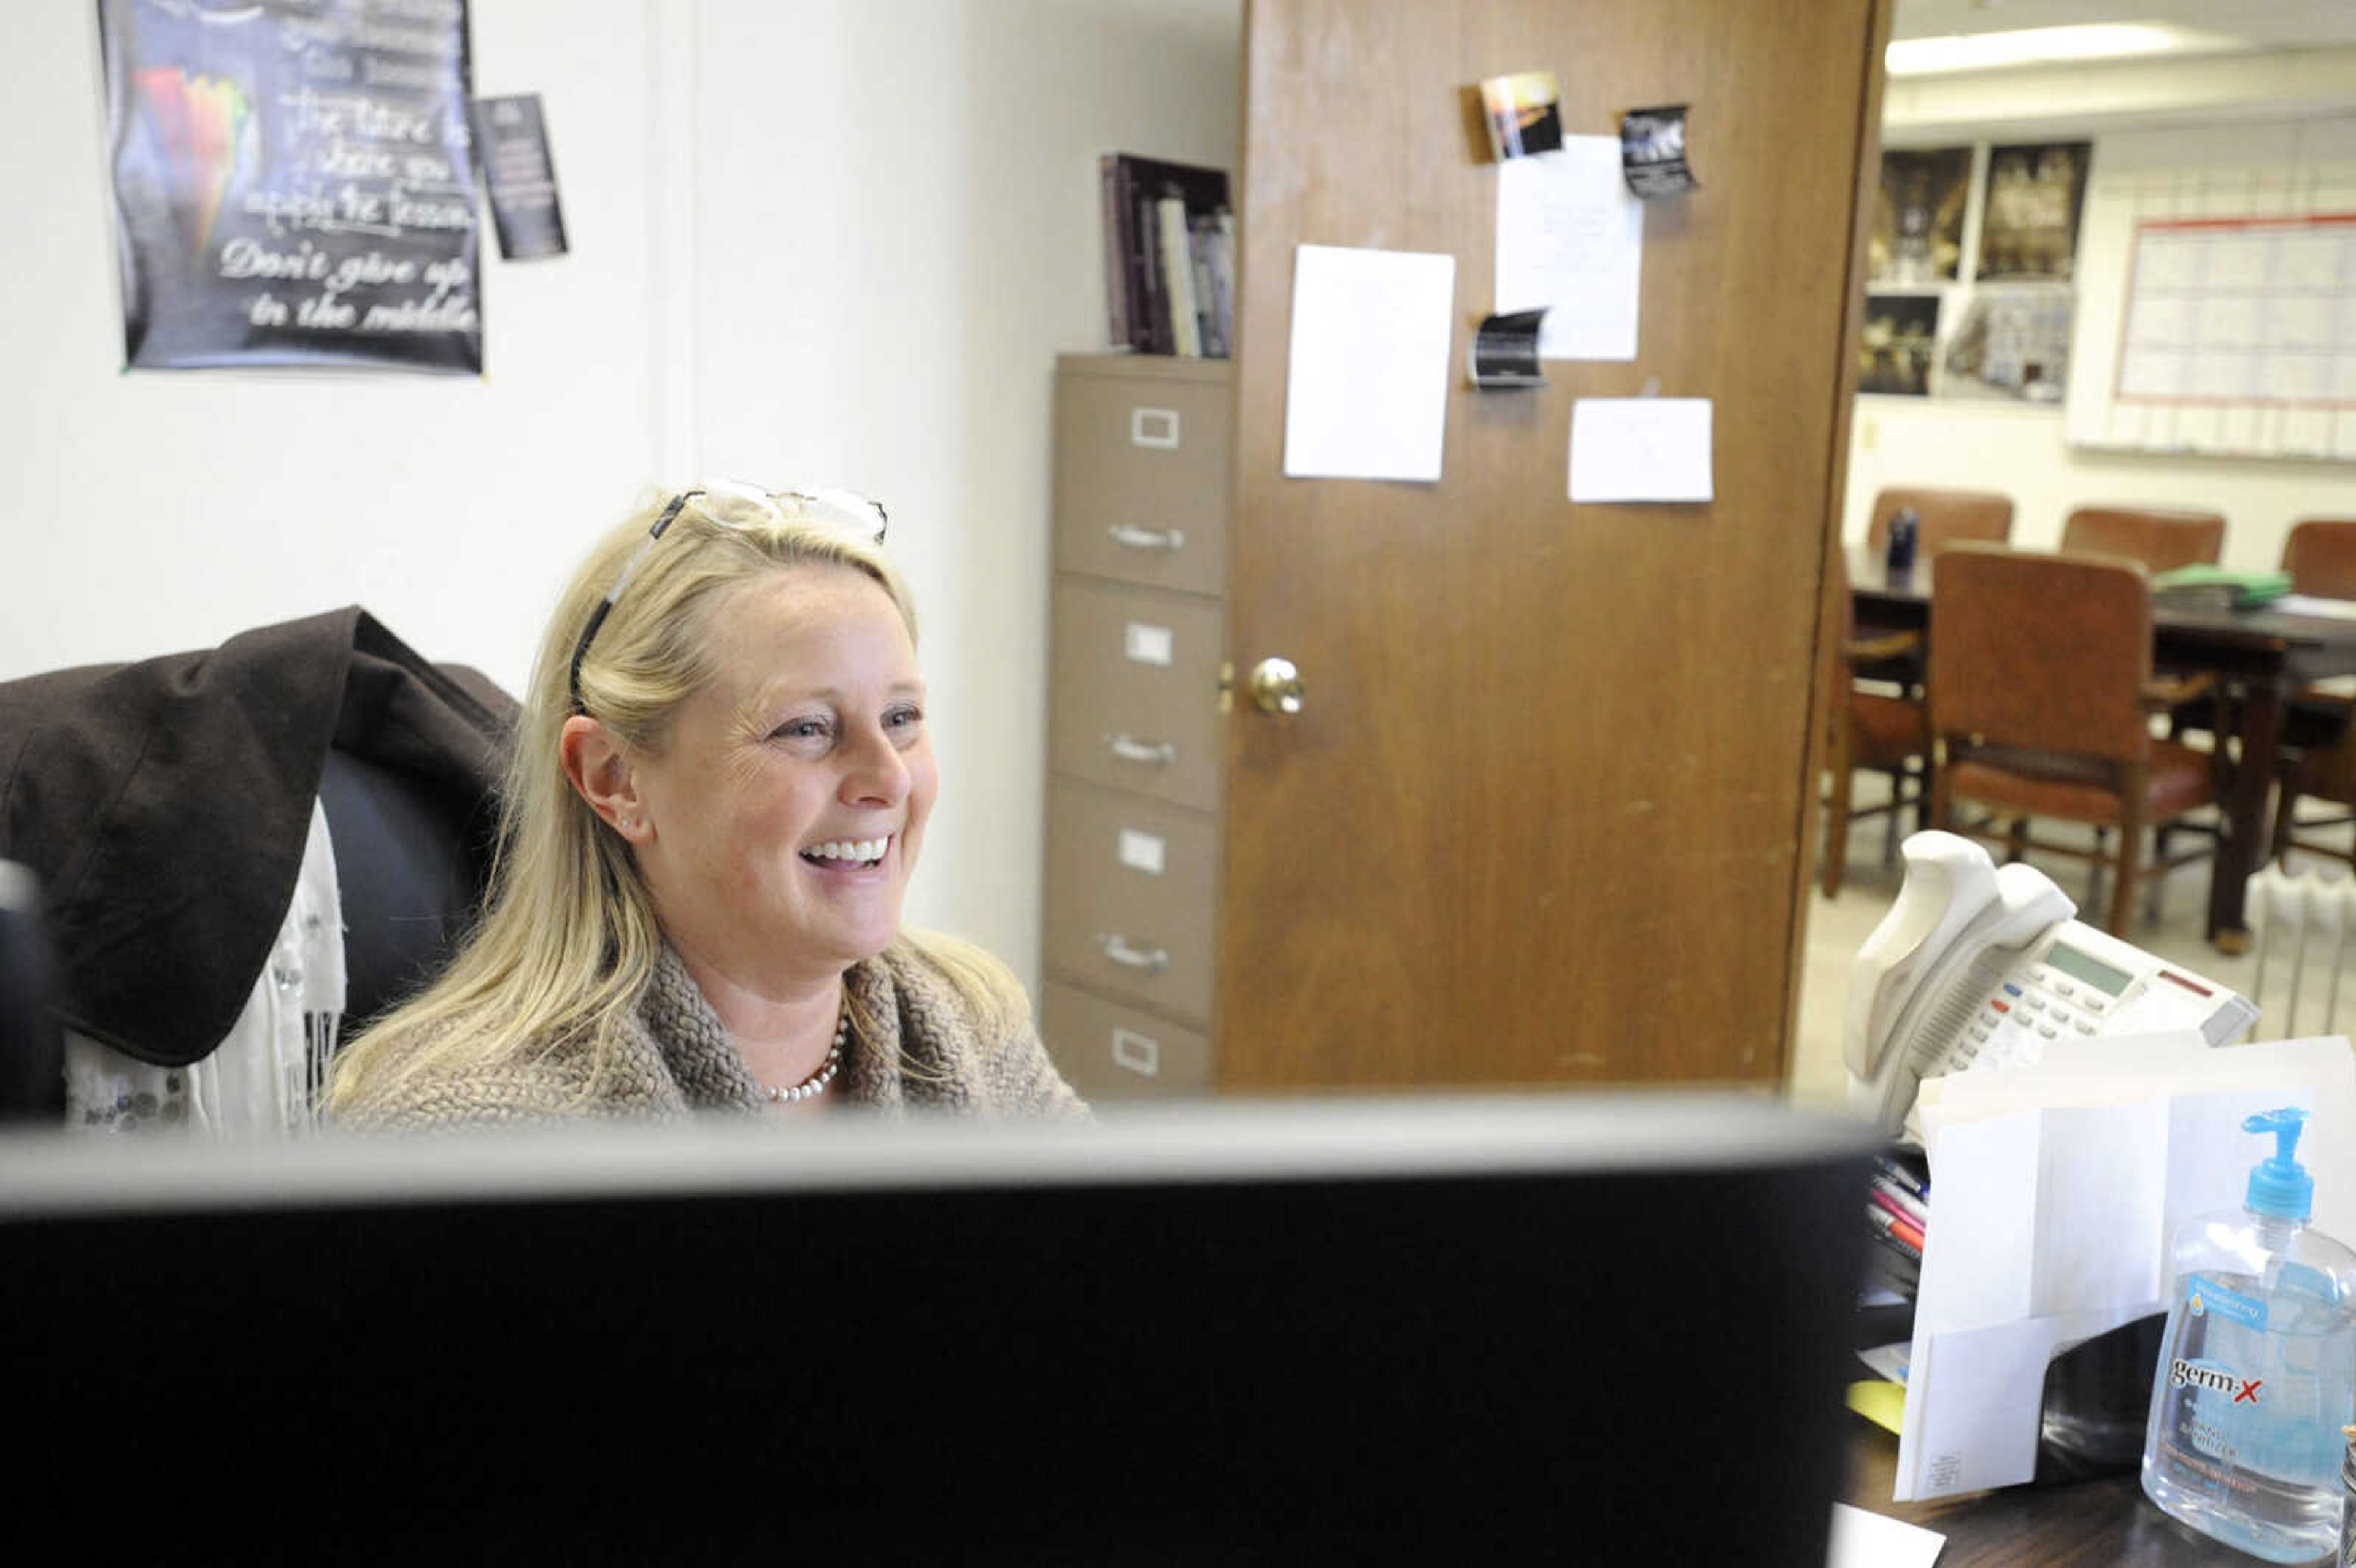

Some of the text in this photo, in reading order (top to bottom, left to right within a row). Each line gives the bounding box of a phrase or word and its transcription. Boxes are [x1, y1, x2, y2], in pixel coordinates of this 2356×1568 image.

[218, 237, 470, 298] Don't give up
[249, 292, 288, 326] in
[296, 292, 358, 329] the
